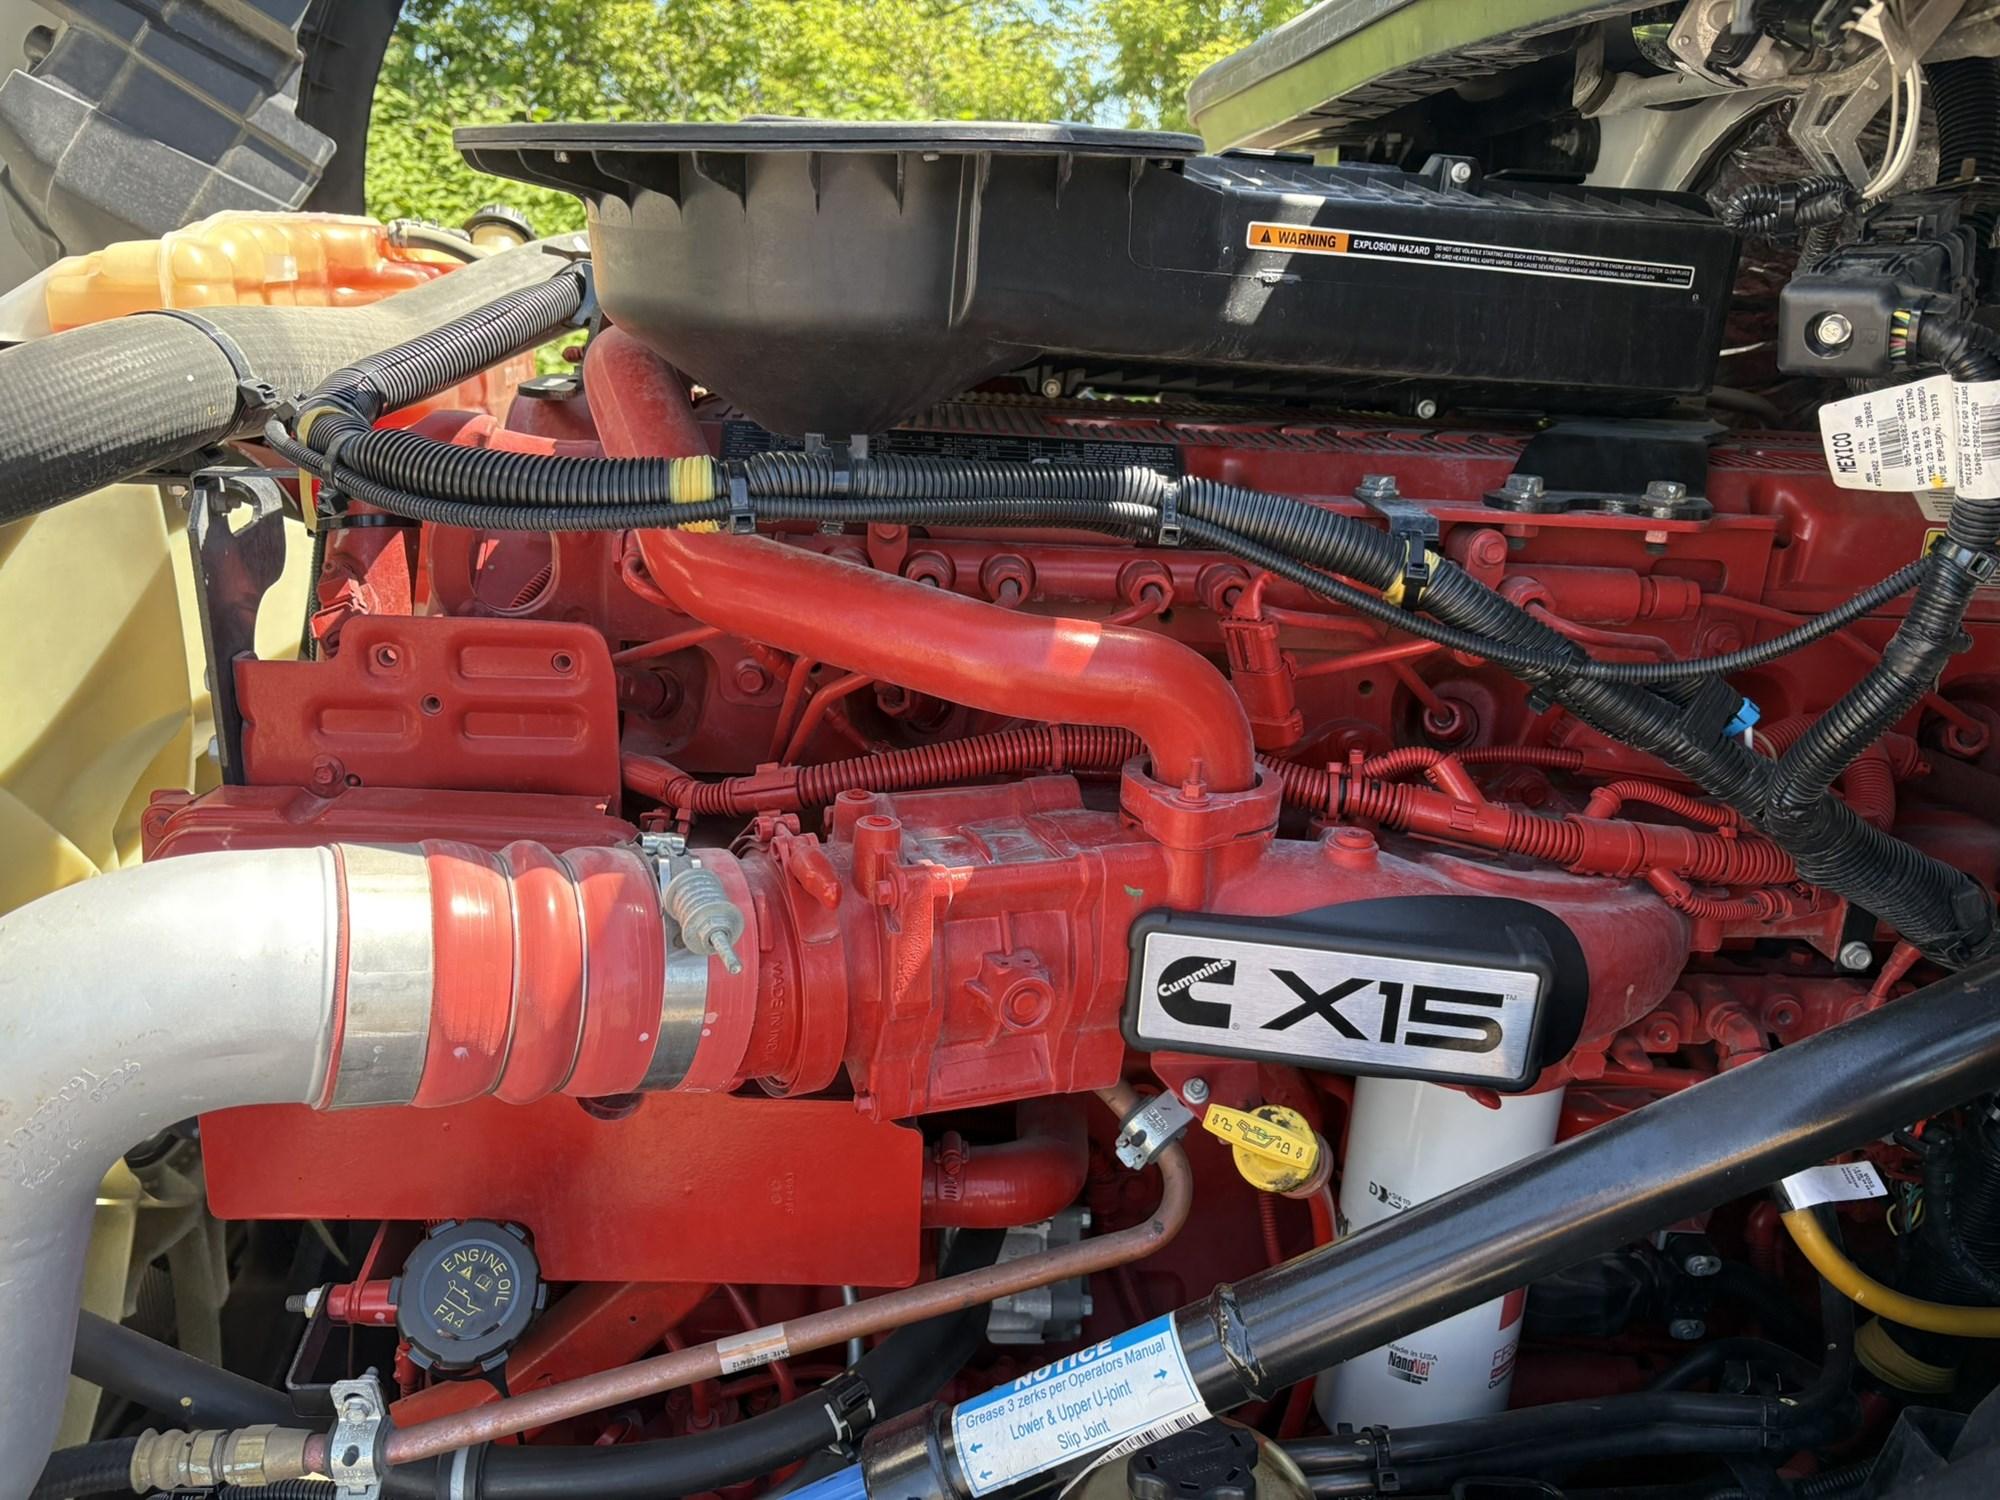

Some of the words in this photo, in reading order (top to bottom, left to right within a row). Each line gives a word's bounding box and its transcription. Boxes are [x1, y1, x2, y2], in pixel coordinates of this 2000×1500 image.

[1278, 230, 1336, 248] WARNING
[1353, 239, 1397, 251] EXPLOSION
[1399, 244, 1430, 255] HAZARD
[1906, 388, 1916, 419] DESTINO
[1832, 433, 1857, 473] MEXICO
[770, 960, 785, 1008] MADE
[1157, 957, 1232, 998] Cummins
[771, 1011, 784, 1026] IN
[1259, 968, 1505, 1054] X15
[441, 1248, 508, 1277] ENGINE
[494, 1278, 511, 1307] OIL
[433, 1304, 465, 1328] FA4
[1013, 1337, 1114, 1392] NOTICE
[1388, 1351, 1430, 1376] NanoNet
[1420, 1352, 1438, 1361] USA
[966, 1403, 1006, 1429] Grease
[1007, 1400, 1015, 1413] 3
[1017, 1389, 1047, 1410] zerks
[1048, 1382, 1067, 1400] per
[1068, 1357, 1124, 1388] Operators
[1125, 1337, 1166, 1363] Manual
[1009, 1414, 1045, 1440] Lower
[1046, 1408, 1056, 1426] &
[1058, 1397, 1094, 1424] Upper
[1094, 1380, 1132, 1410] U-joint
[1057, 1430, 1080, 1450] Slip
[1083, 1417, 1111, 1442] Joint
